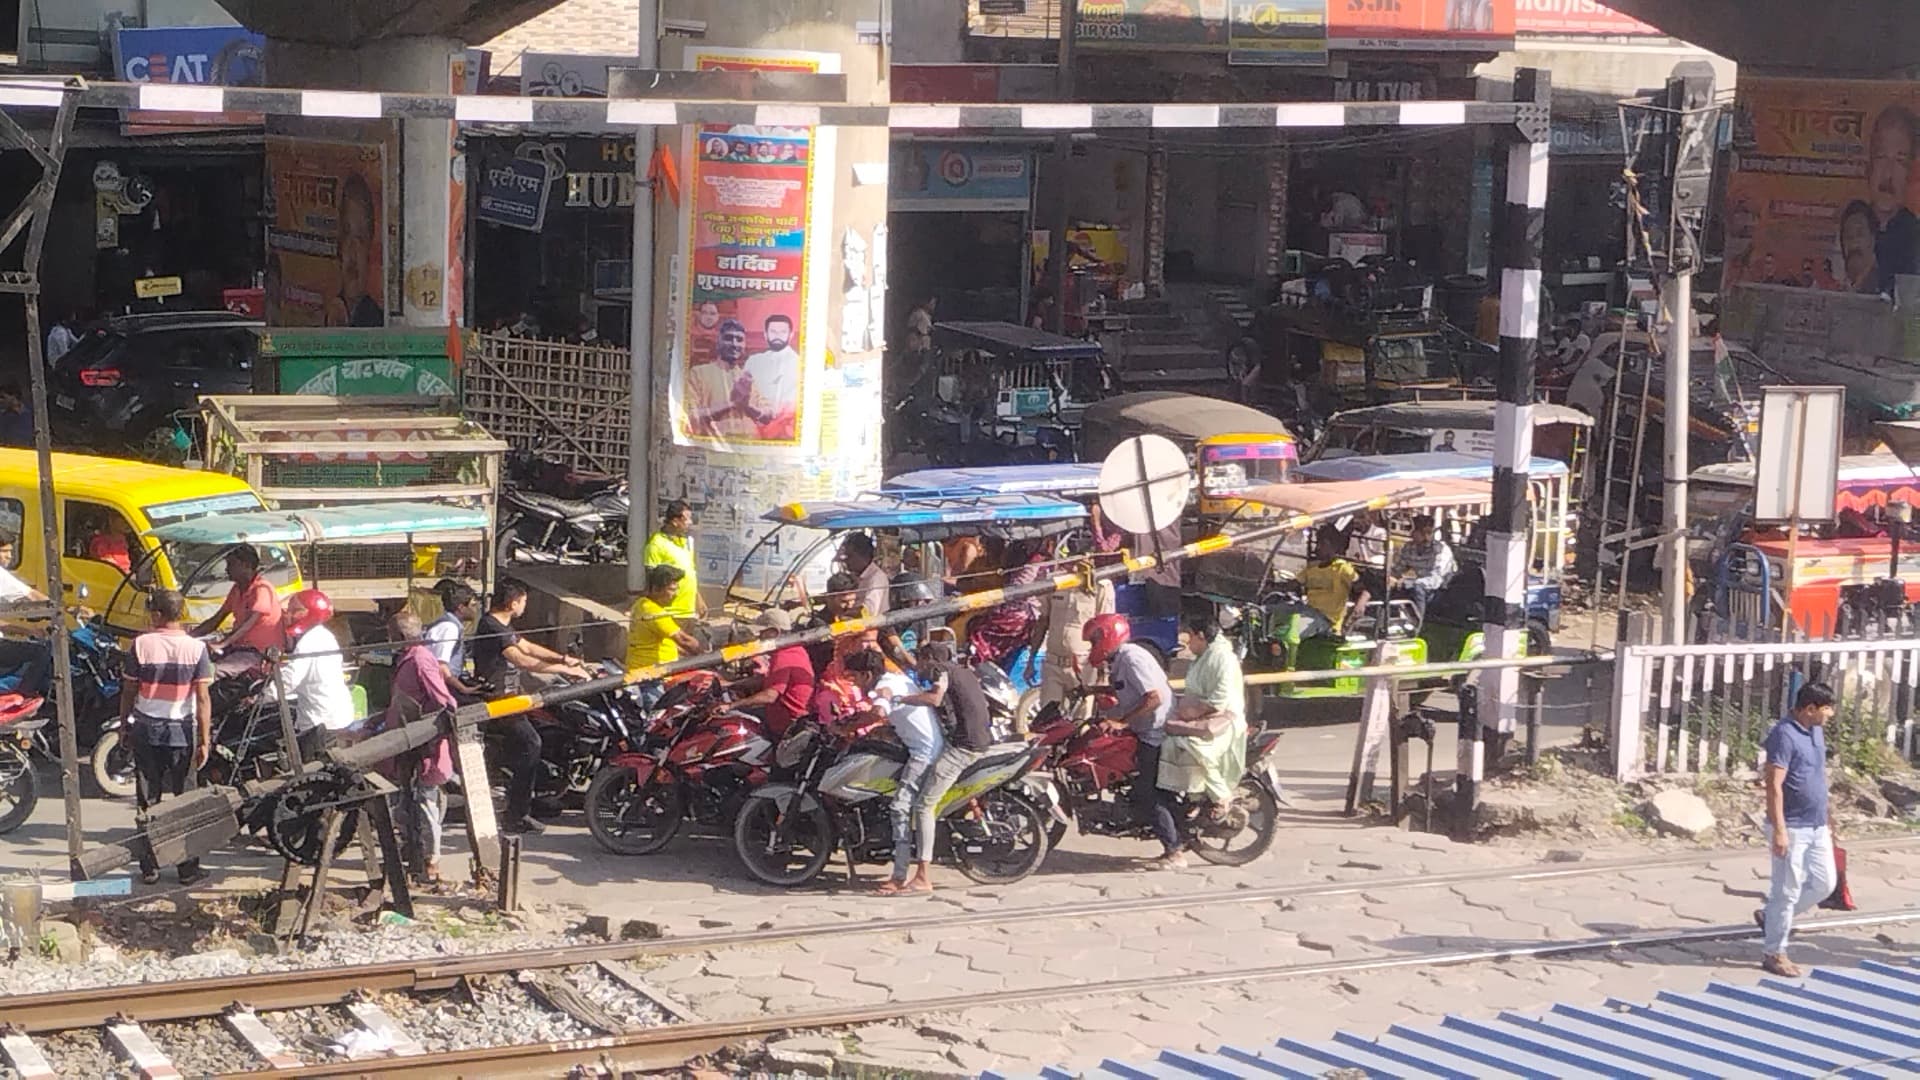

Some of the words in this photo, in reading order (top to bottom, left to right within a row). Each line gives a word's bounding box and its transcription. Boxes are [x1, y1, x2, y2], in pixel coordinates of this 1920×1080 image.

[126, 54, 208, 83] CEAT
[488, 166, 541, 193] एटीएम
[716, 254, 778, 272] हार्दिक
[421, 290, 437, 306] 12
